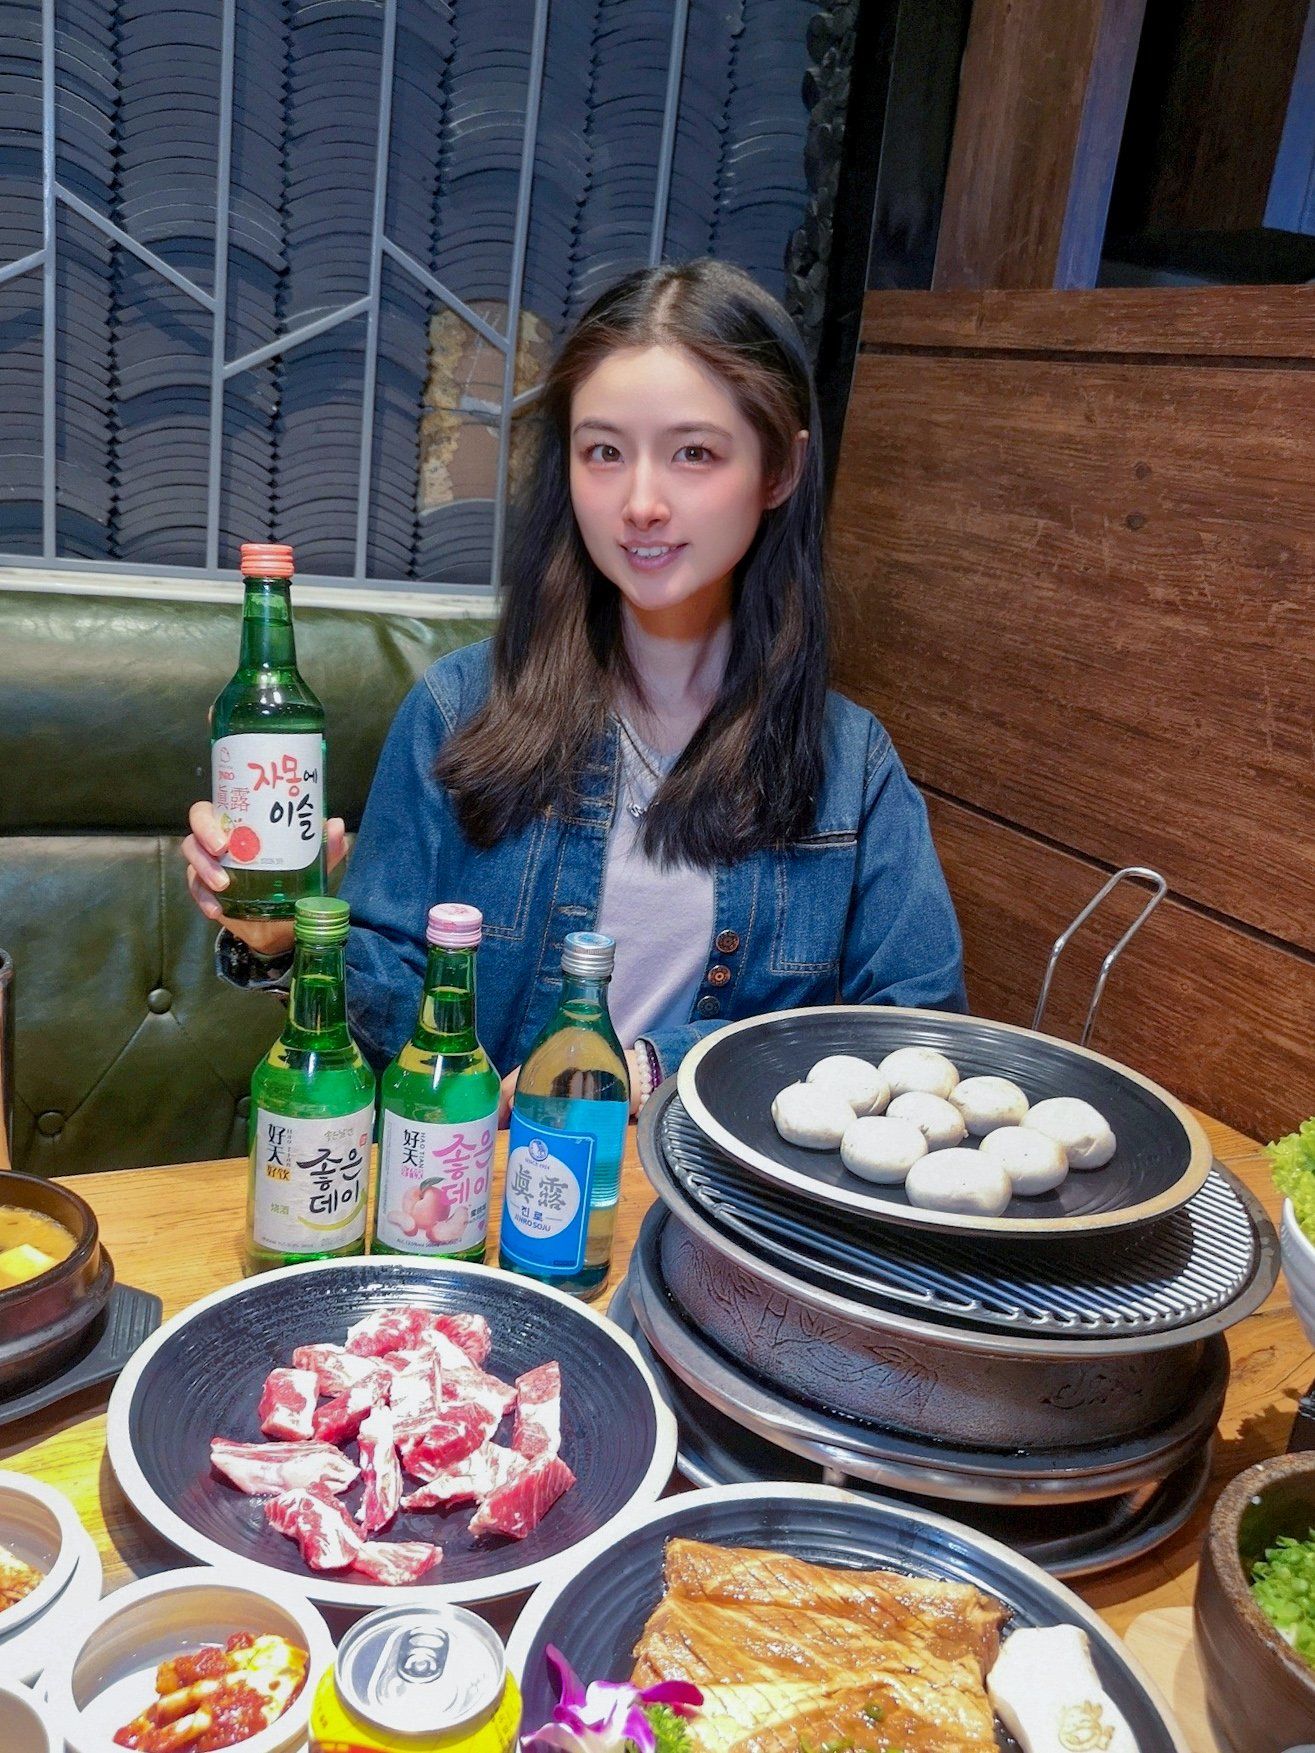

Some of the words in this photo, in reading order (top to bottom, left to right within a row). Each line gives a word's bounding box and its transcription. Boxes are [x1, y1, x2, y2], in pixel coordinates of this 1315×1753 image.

[247, 755, 318, 797] 자몽에
[269, 794, 316, 841] 이슬
[268, 1124, 287, 1166] 好天
[402, 1129, 420, 1167] 好天
[432, 1129, 494, 1181] 좋은
[296, 1148, 363, 1191] 좋은
[441, 1167, 489, 1206] 데이
[309, 1180, 360, 1214] 데이
[532, 1221, 551, 1232] SOJU
